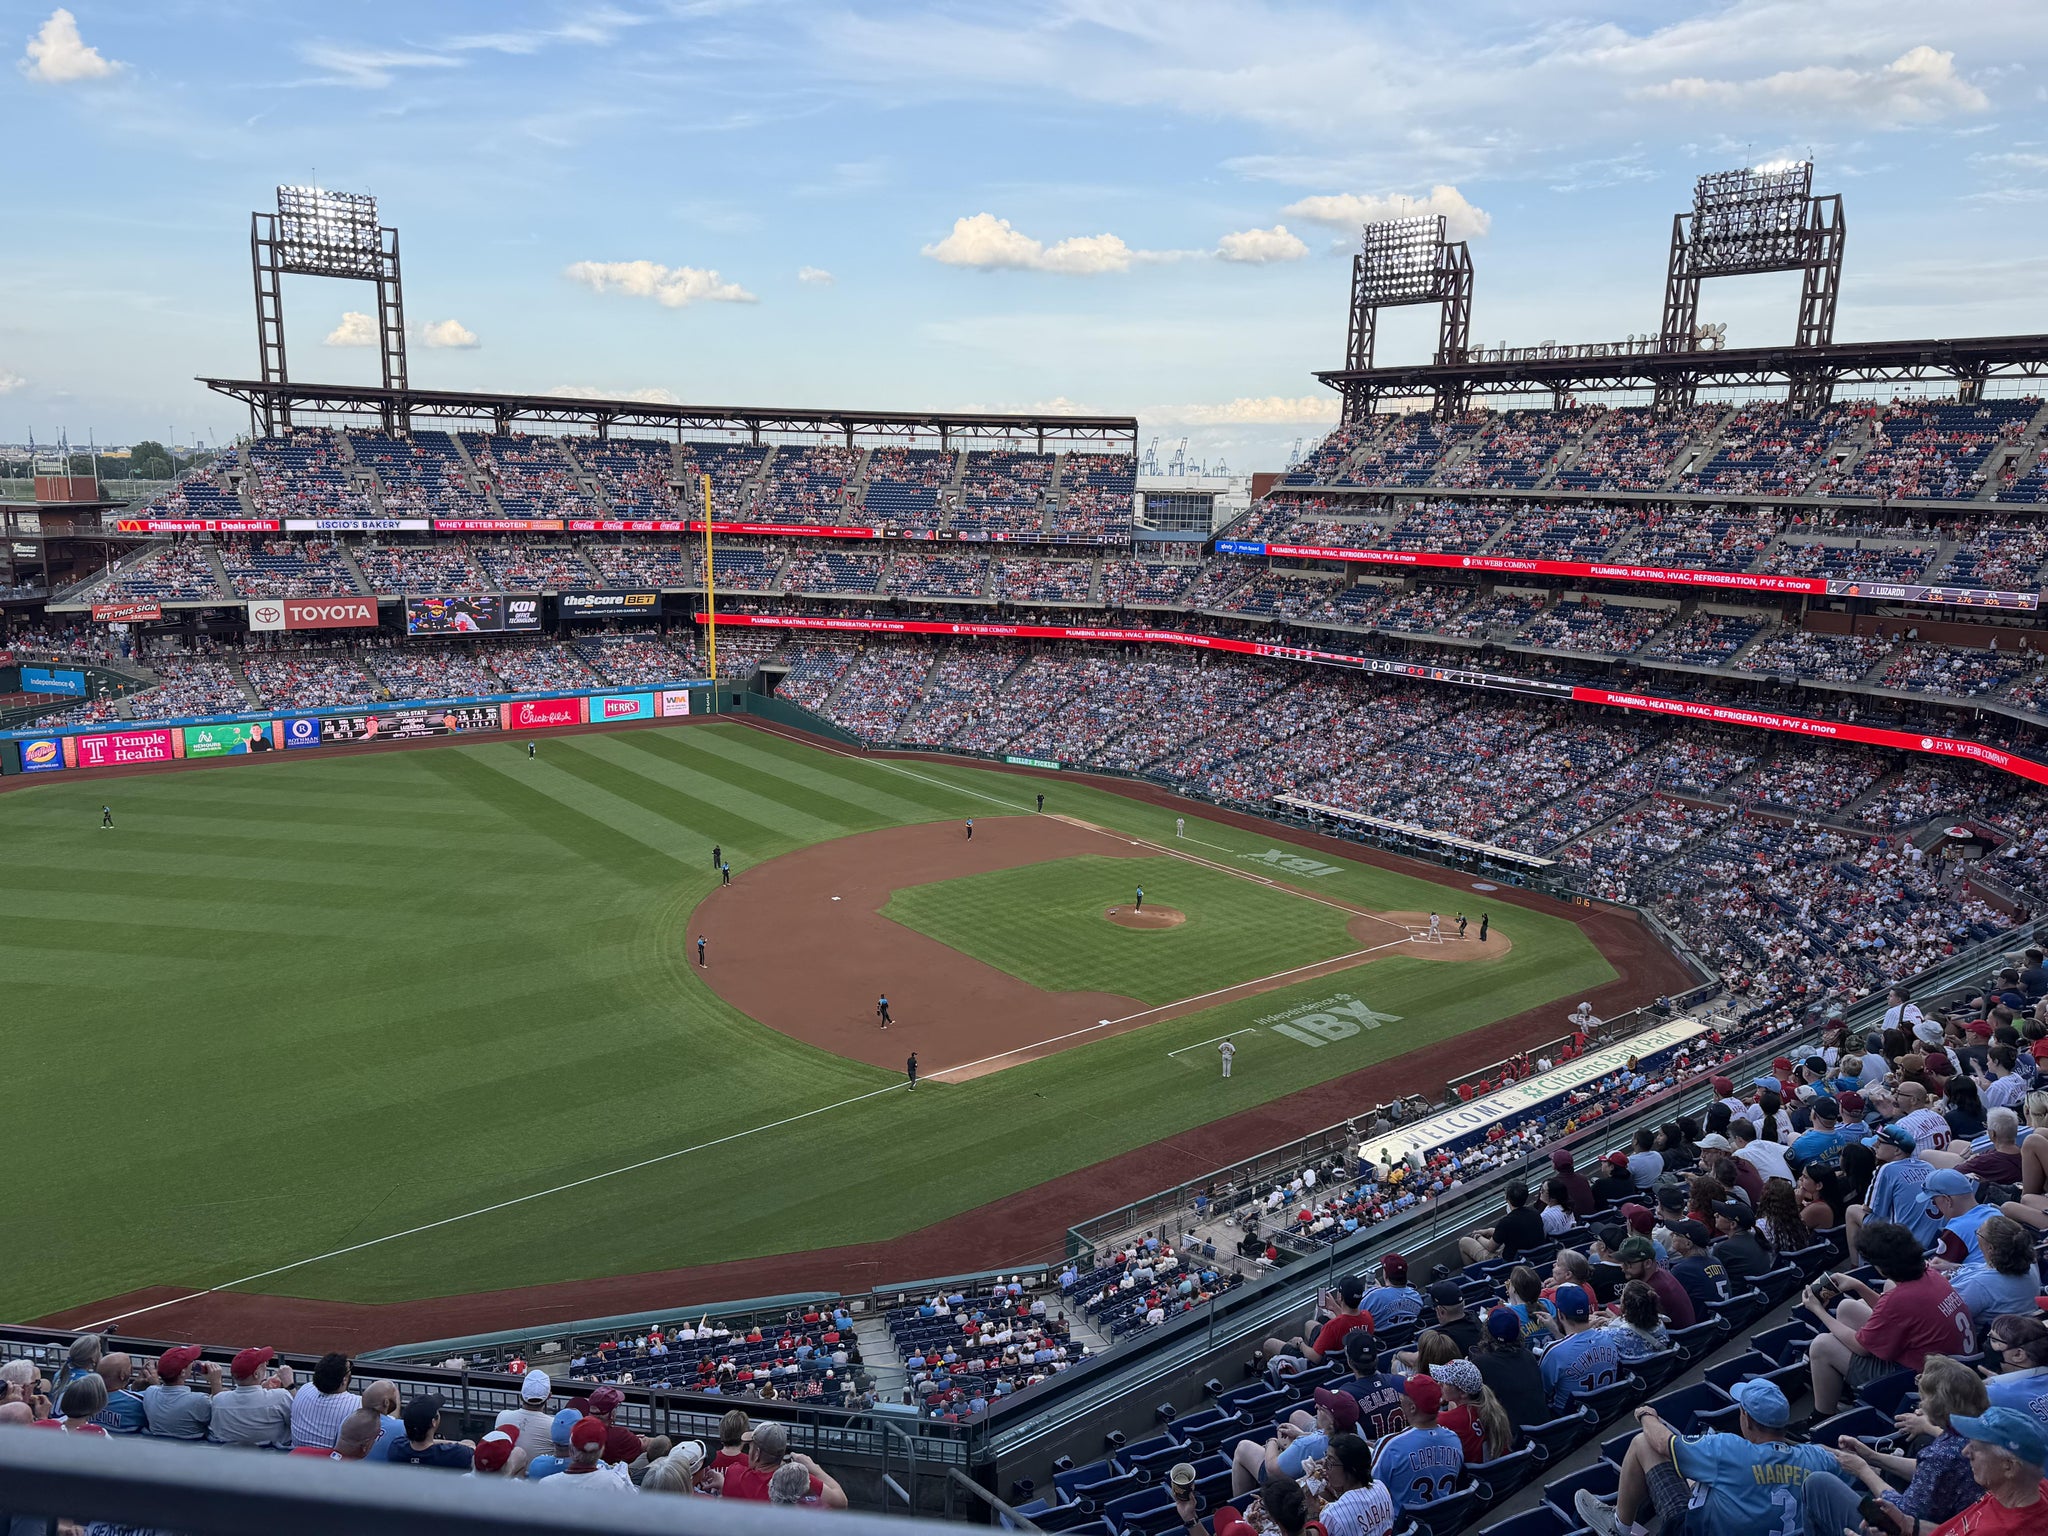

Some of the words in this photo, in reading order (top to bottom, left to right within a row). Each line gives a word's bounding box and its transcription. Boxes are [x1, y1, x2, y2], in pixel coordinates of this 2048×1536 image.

[148, 522, 182, 530] Phillies
[184, 522, 200, 530] win
[221, 522, 246, 530] Deals
[248, 522, 262, 530] roll
[263, 522, 272, 530] in
[316, 521, 359, 529] LISCIO'S
[362, 521, 400, 529] BAKERY
[1272, 546, 1298, 555] PLUMBING,
[1299, 548, 1322, 556] HEATING,
[1322, 550, 1339, 558] HVAC,
[1340, 551, 1382, 560] REFRIGERATION,
[1504, 561, 1538, 570] COMPANY
[1591, 567, 1630, 577] PLUMBING,
[1631, 570, 1666, 580] HEATING,
[1667, 572, 1692, 582] HVAC,
[1694, 574, 1758, 587] REFRIGERATION,
[1760, 579, 1776, 587] PVF
[1778, 580, 1785, 588] &
[1787, 582, 1811, 590] more
[1870, 586, 1875, 595] J.
[1876, 586, 1906, 597] LUZARDO
[509, 601, 536, 613] KDI
[564, 595, 624, 606] theScore
[628, 596, 653, 604] BET
[96, 612, 112, 620] HIT
[114, 608, 134, 618] THIS
[136, 604, 158, 613] SIGN
[290, 605, 371, 621] TOYOTA
[827, 621, 870, 629] REFRIGERATION,
[1372, 661, 1391, 672] 0-0
[31, 679, 68, 688] Independence
[608, 702, 636, 713] HERR'S
[1608, 694, 1648, 706] PLUMBING,
[1649, 701, 1685, 712] HEATING,
[1686, 706, 1712, 717] HVAC,
[1714, 710, 1781, 726] REFRIGERATION,
[1783, 719, 1800, 729] PVF
[1802, 722, 1809, 730] &
[1811, 726, 1837, 734] more
[520, 706, 572, 725] Chick-fil-A
[113, 733, 166, 748] Temple
[115, 747, 164, 761] Health
[1936, 741, 1954, 751] F.W.
[1957, 744, 1981, 757] WEBB
[1982, 750, 2010, 766] COMPANY
[1034, 760, 1059, 769] PICKLES
[1247, 849, 1345, 876] IBX
[1253, 998, 1337, 1025] Independence
[1270, 1000, 1405, 1048] IBX
[1402, 1099, 1514, 1145] WELCOME
[1538, 1061, 1610, 1092] Citizens
[1604, 1044, 1645, 1068] Bank
[1638, 1030, 1682, 1049] Park
[1716, 1280, 1729, 1301] 5
[1955, 1312, 1975, 1354] 3
[513, 1364, 518, 1372] 3
[1409, 1445, 1459, 1473] CARLTON
[1769, 1489, 1798, 1536] 3
